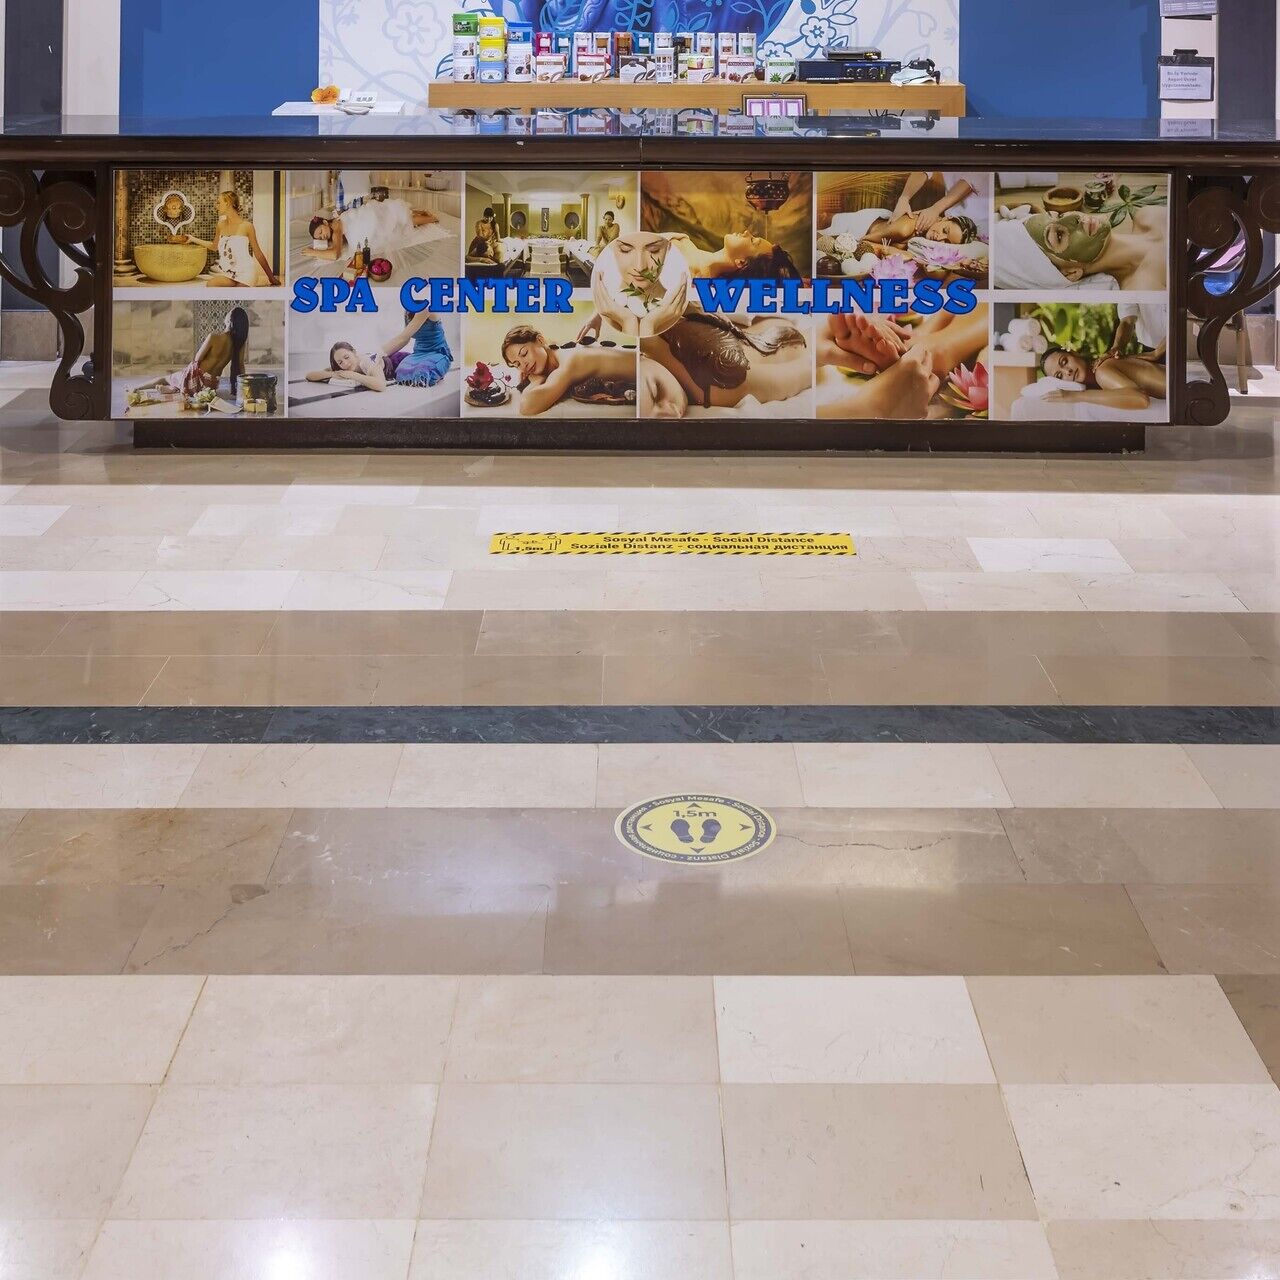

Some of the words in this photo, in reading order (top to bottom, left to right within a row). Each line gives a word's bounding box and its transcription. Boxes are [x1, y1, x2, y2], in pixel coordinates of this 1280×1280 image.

[290, 276, 378, 314] SPA
[399, 276, 574, 314] CENTER
[692, 277, 978, 315] WELLNESS
[652, 796, 685, 806] Sosyal
[672, 810, 717, 818] 1,5m
